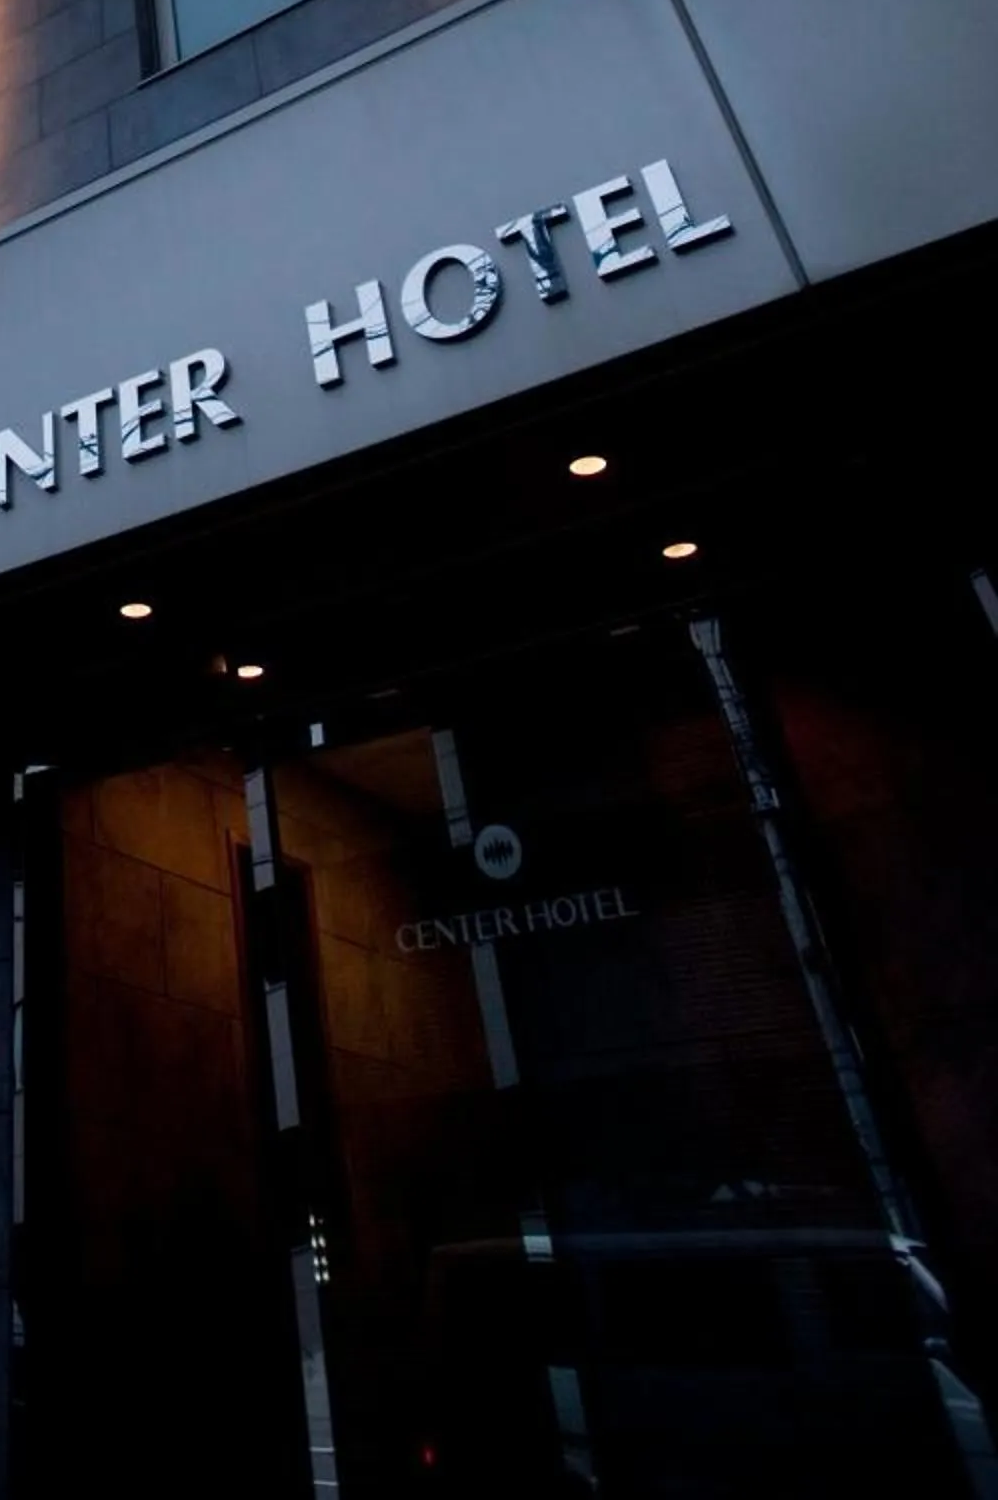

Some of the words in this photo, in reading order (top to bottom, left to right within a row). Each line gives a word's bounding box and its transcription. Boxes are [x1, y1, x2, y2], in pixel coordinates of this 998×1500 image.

[305, 159, 734, 390] HOTEL
[395, 905, 520, 952] CENTER
[523, 886, 641, 933] HOTEL
